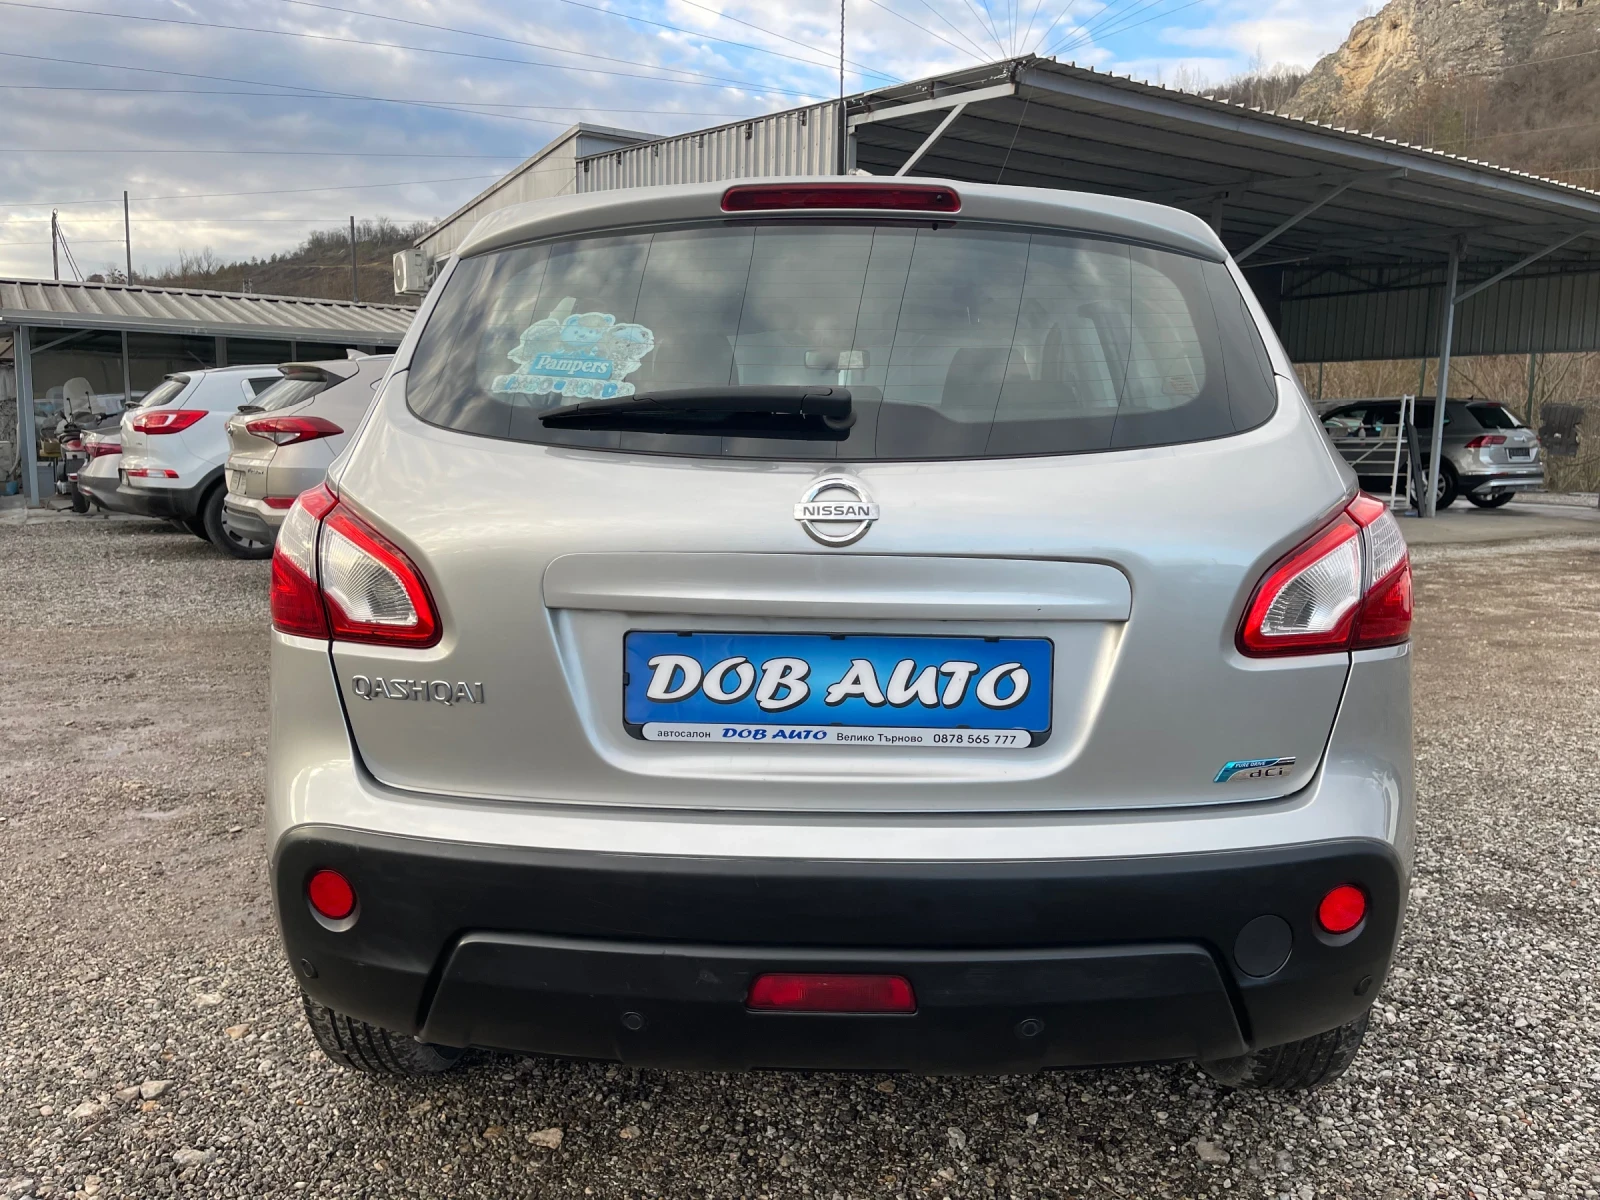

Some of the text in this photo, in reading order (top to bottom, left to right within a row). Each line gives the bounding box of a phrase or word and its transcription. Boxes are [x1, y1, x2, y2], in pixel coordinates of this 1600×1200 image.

[535, 355, 610, 375] Pampers
[803, 505, 870, 516] NISSAN
[352, 674, 485, 706] QASHQAI
[646, 654, 1032, 713] DOB AUTO
[657, 728, 1017, 745] автосалон DOB AUTO Велико Търново 0878 565 777
[1249, 767, 1283, 778] dCi
